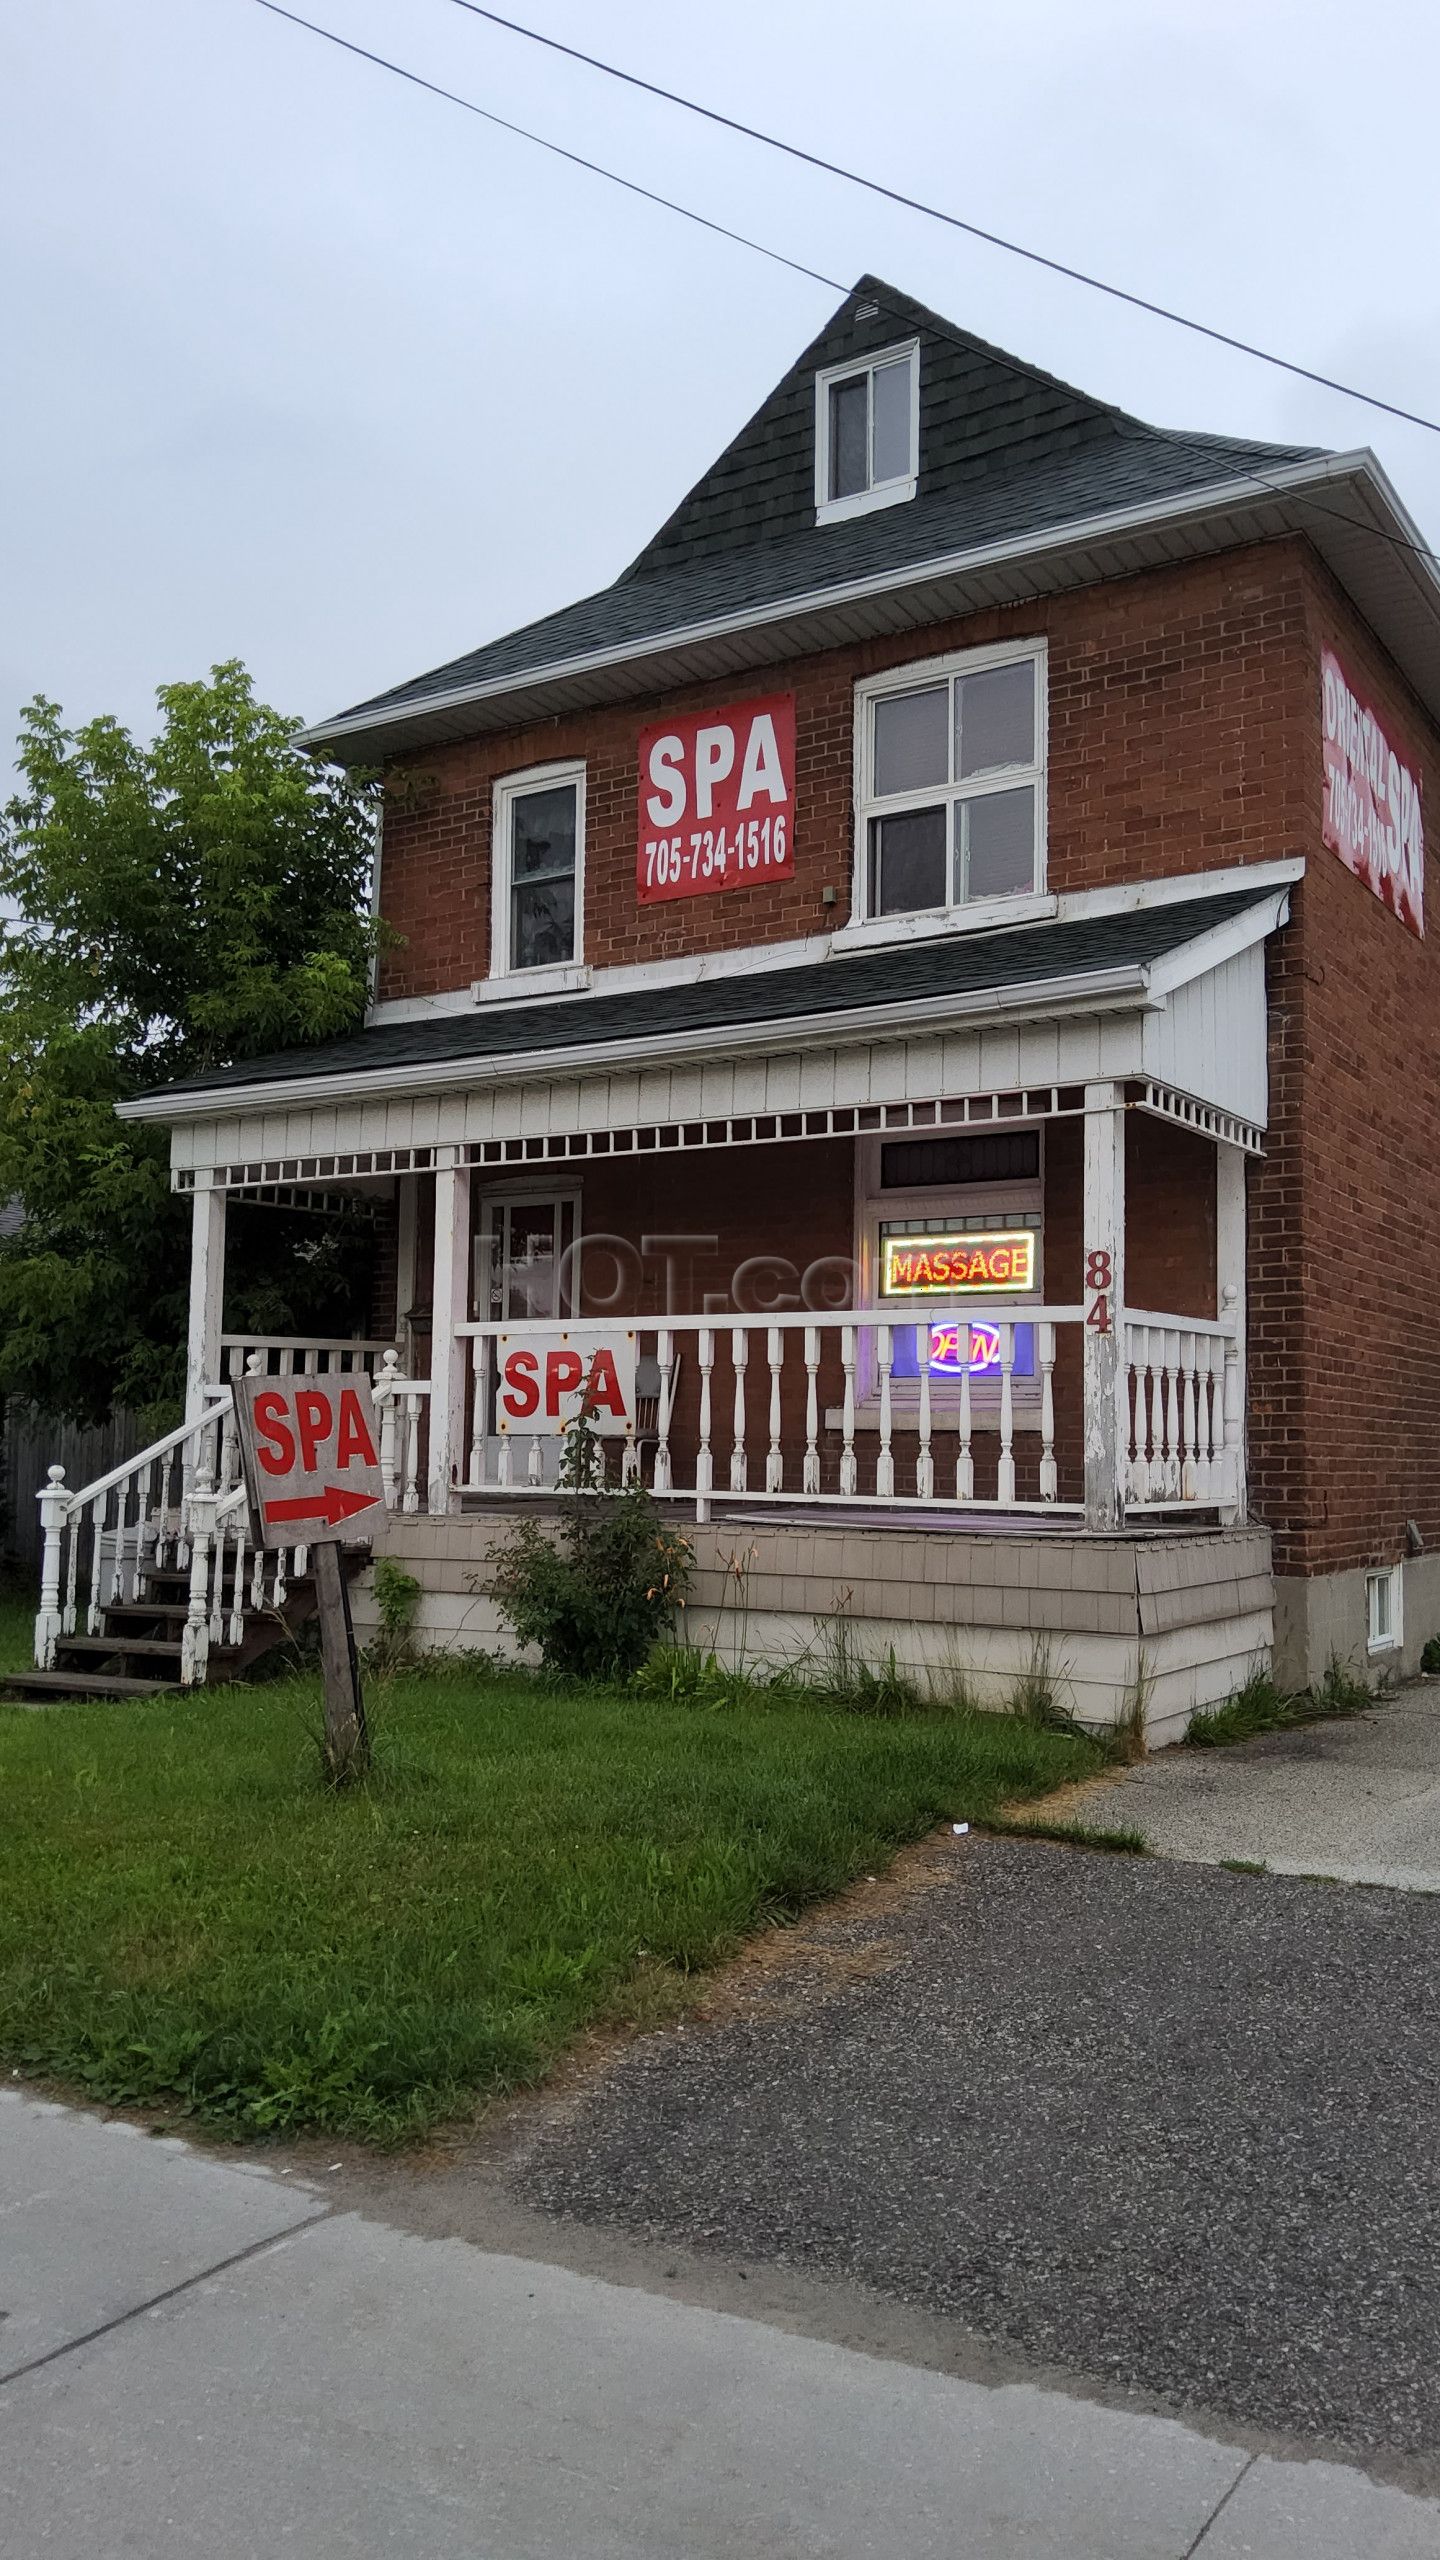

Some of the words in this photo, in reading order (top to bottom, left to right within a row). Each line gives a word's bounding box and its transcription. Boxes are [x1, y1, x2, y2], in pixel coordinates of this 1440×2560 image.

[646, 714, 788, 828] SPA
[645, 815, 786, 887] 705-734-1516
[1386, 750, 1423, 895] SPA
[890, 1247, 1028, 1283] MASSAGE
[502, 1348, 627, 1418] SPA
[253, 1389, 379, 1476] SPA
